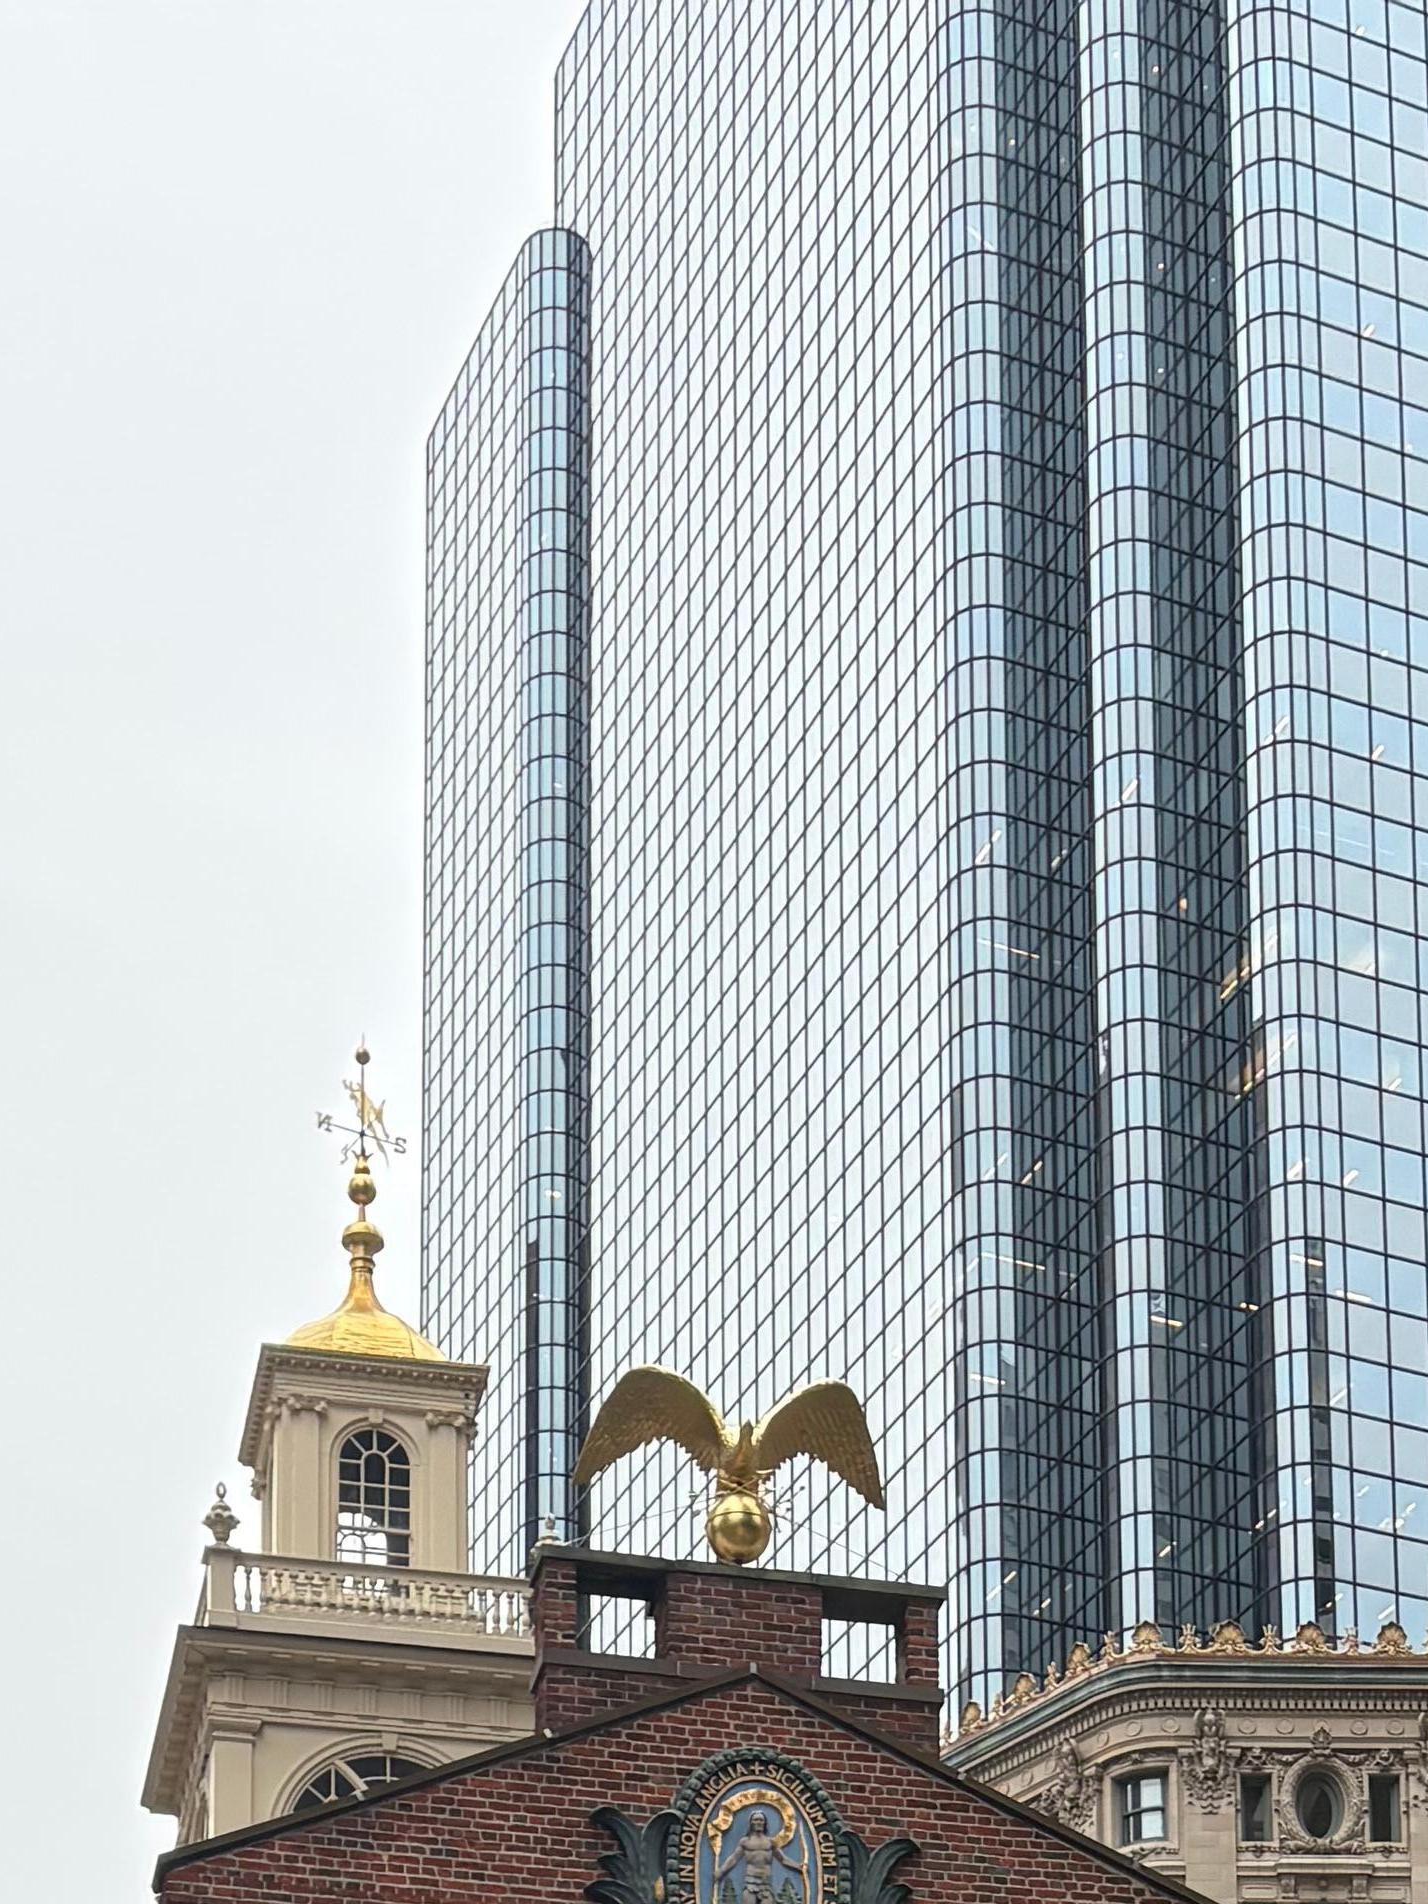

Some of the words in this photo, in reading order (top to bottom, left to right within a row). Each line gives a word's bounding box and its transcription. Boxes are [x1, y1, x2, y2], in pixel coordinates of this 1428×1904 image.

[679, 1813, 702, 1860] NOVA
[818, 1830, 837, 1867] CUM
[679, 1863, 695, 1883] IN
[822, 1873, 838, 1895] ET
